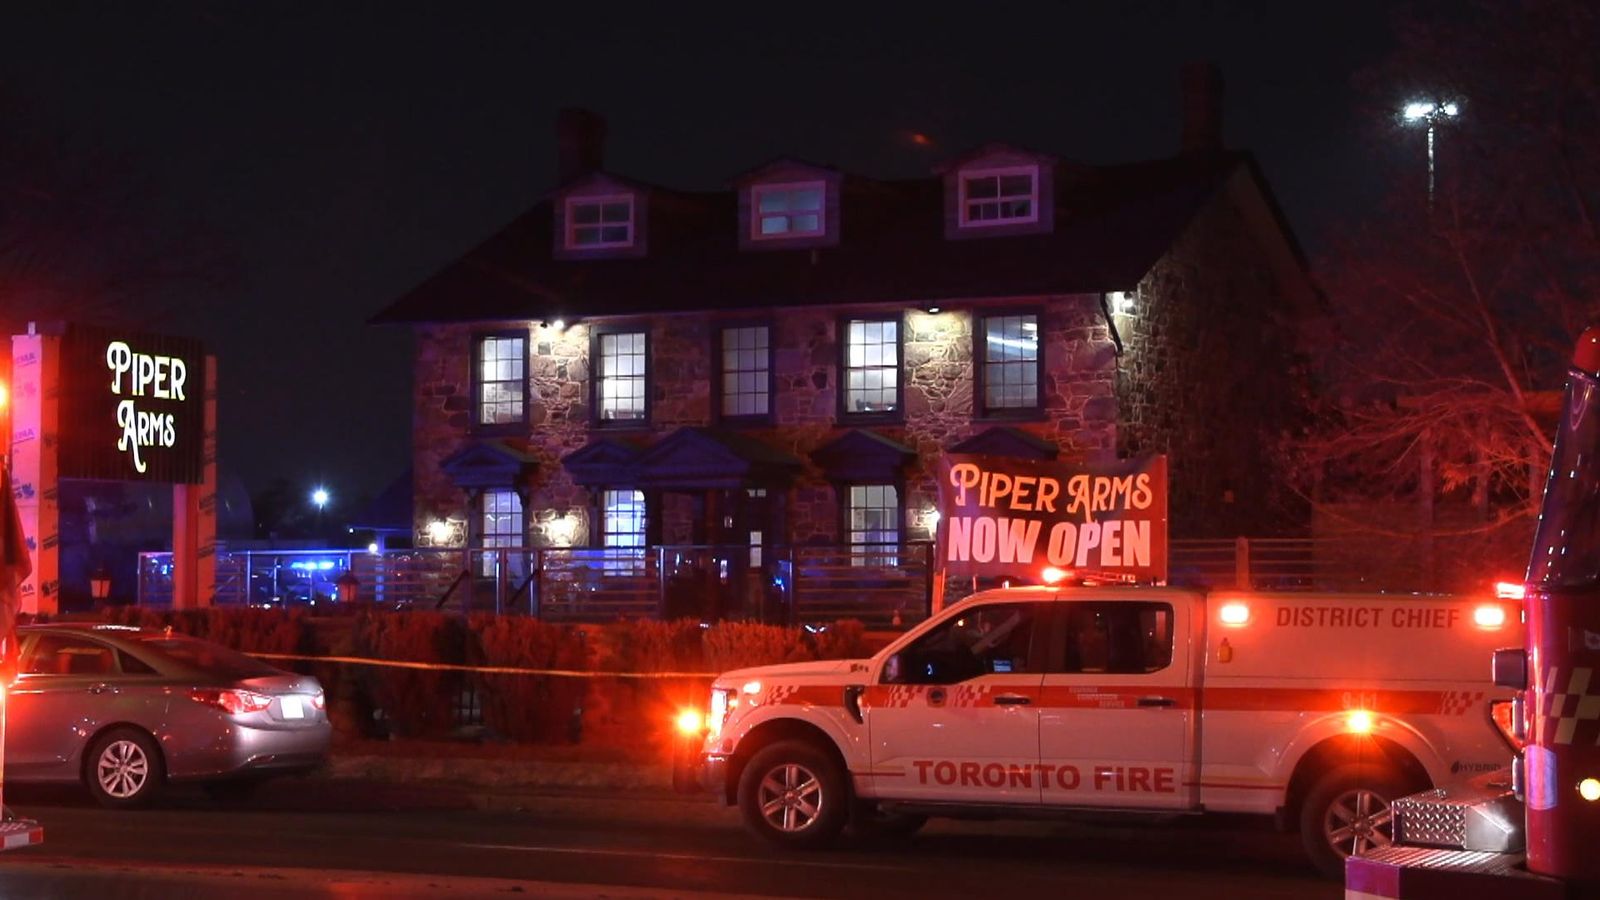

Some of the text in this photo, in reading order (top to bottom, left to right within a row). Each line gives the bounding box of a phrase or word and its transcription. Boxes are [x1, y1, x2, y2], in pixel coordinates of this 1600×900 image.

[107, 342, 186, 401] PIPER
[117, 400, 176, 473] ARMS
[949, 463, 1153, 522] PIPER ARMS
[948, 517, 1151, 567] NOW OPEN
[1277, 607, 1461, 629] DISTRICT CHIEF
[913, 760, 1176, 793] TORONTO FIRE
